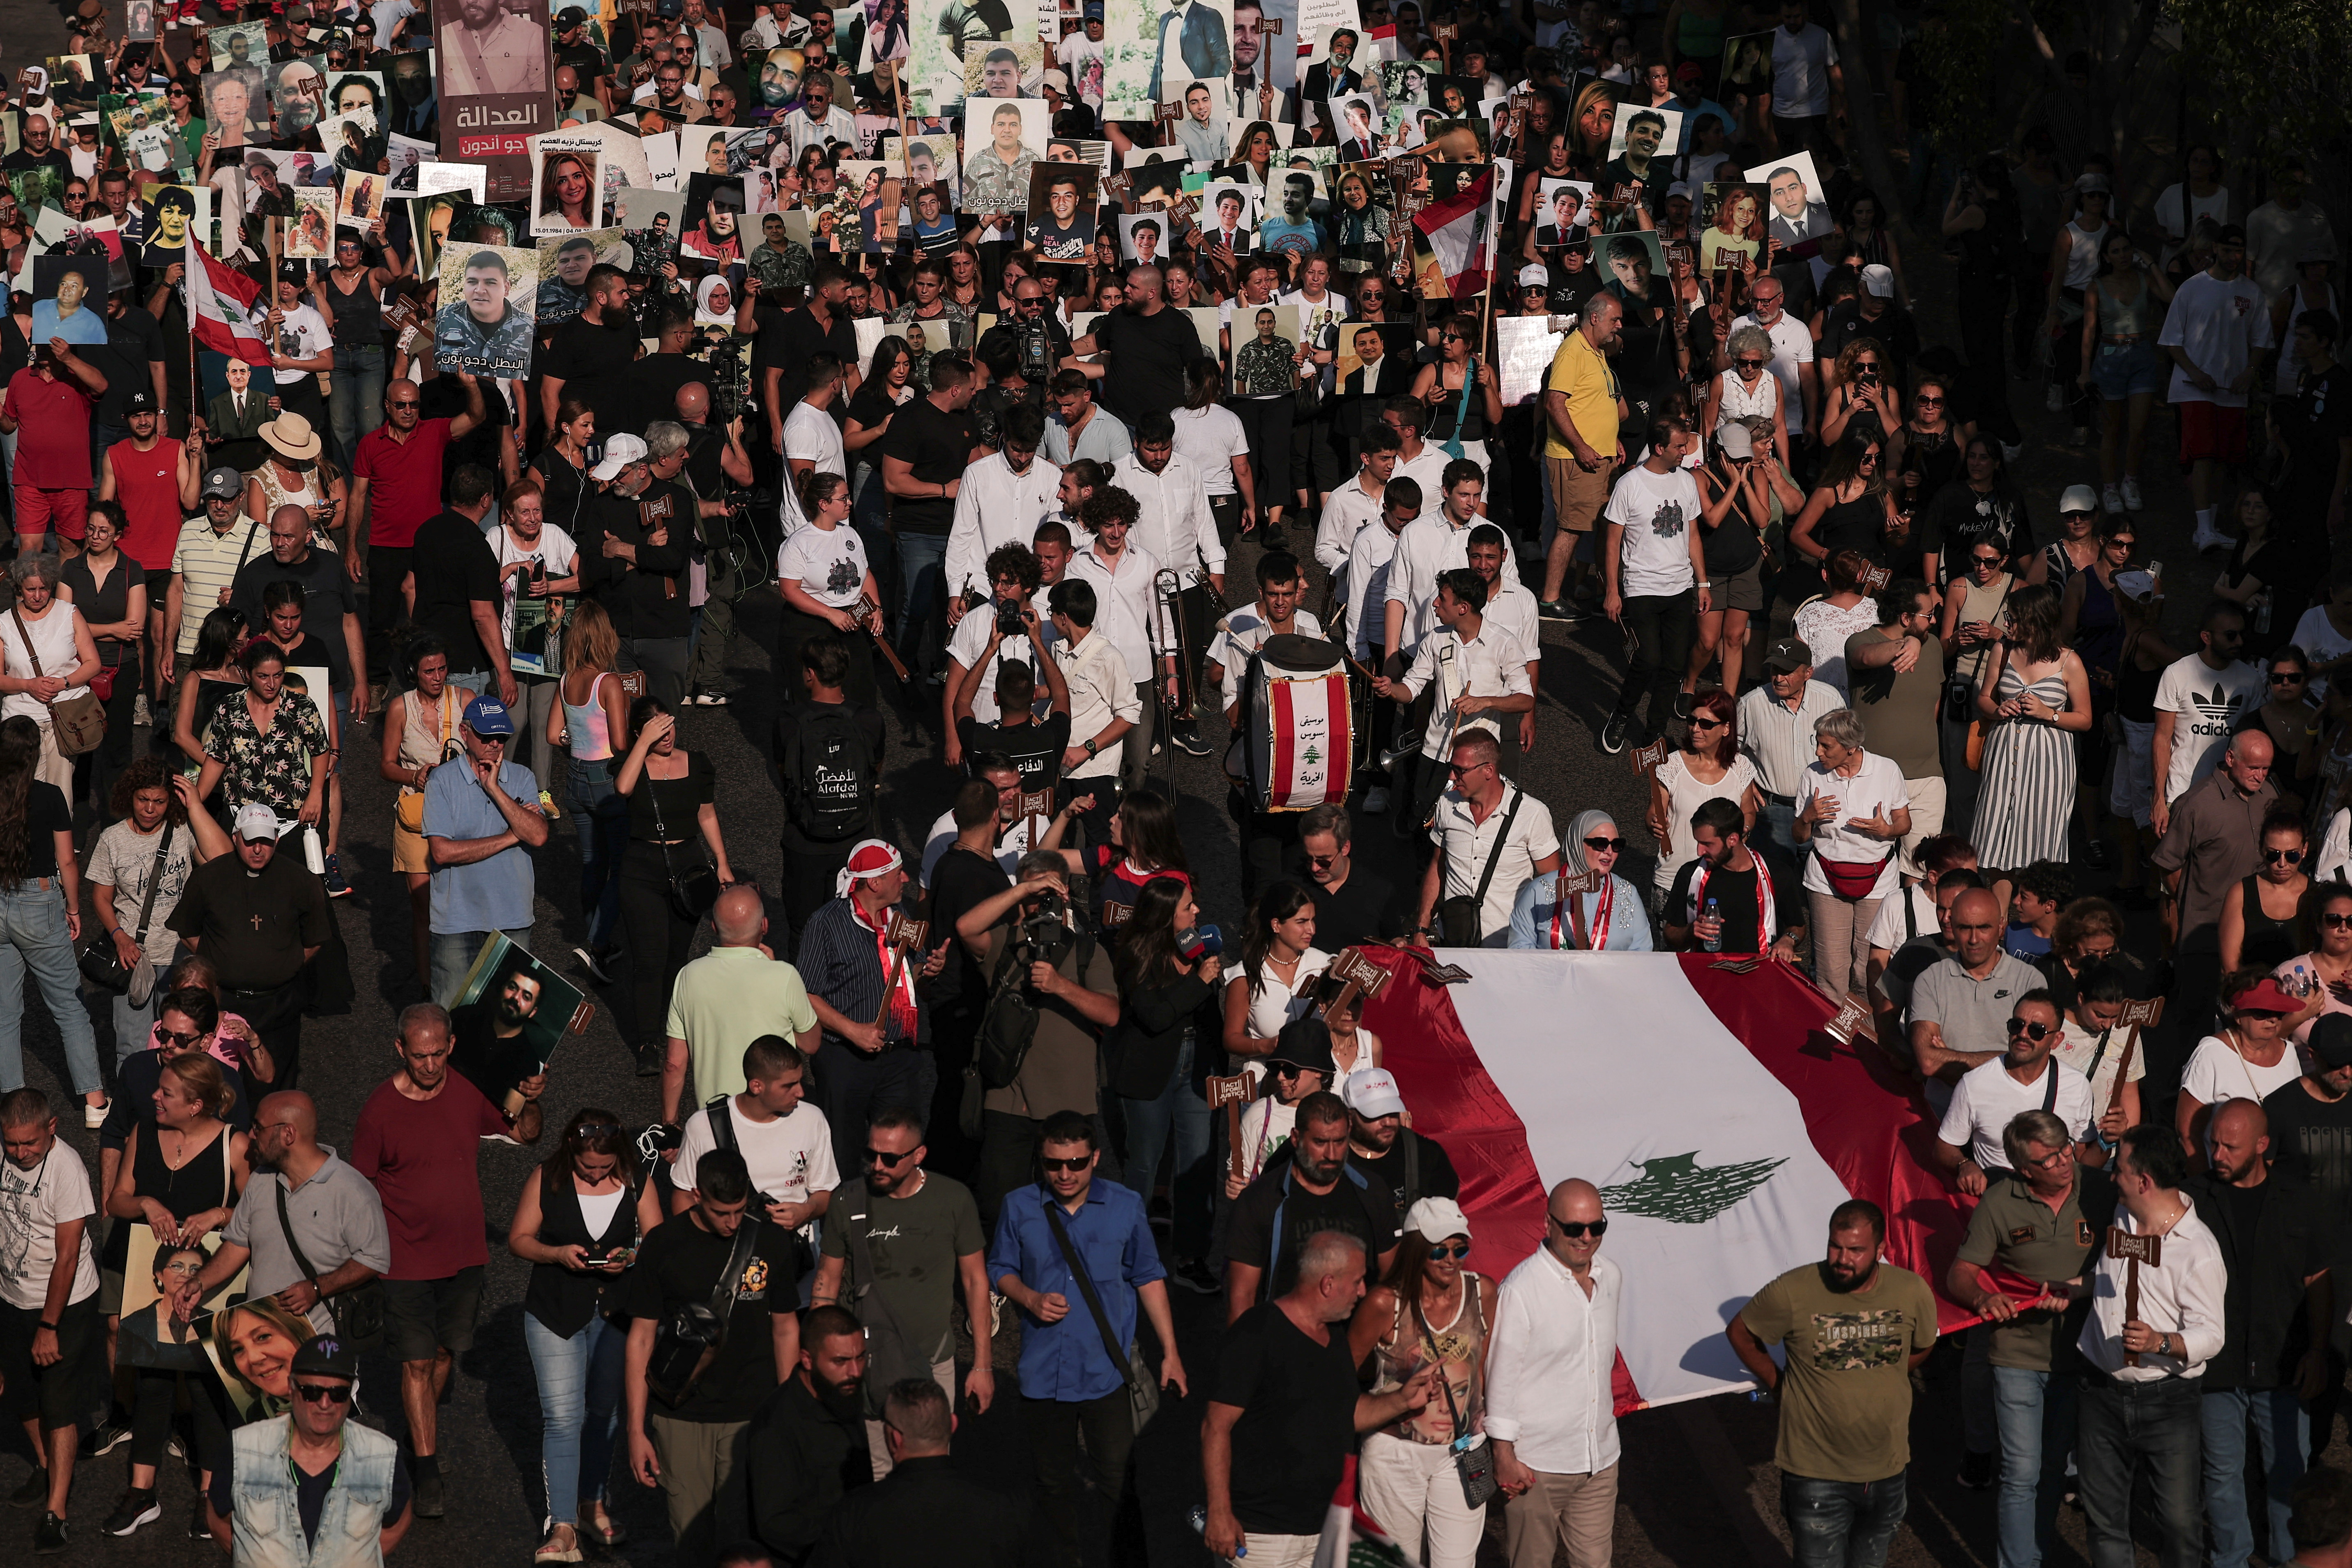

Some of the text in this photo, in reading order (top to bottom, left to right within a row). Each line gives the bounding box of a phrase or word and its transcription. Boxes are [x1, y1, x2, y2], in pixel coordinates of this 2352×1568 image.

[1307, 0, 1339, 11] المطلوبين
[1304, 13, 1333, 21] وظائفهم
[457, 104, 538, 127] العدالة
[142, 145, 159, 154] adidas
[462, 135, 524, 155] جو أندون
[655, 168, 676, 182] لمحو
[968, 197, 1007, 207] دجو نون
[1178, 208, 1191, 217] JUSTICE
[2235, 300, 2249, 309] BULLS
[540, 308, 580, 320] دجو نون
[441, 354, 524, 370] البطل دجو نون
[650, 508, 667, 516] JUSTICE
[1866, 576, 1883, 585] JUSTICE
[856, 606, 869, 621] JUSTICE
[857, 607, 867, 615] FOR
[1300, 716, 1324, 727] موسيقى
[1300, 730, 1325, 740] بسوس
[2191, 722, 2233, 737] adida
[828, 744, 840, 753] LIU
[1642, 755, 1660, 765] JUSTICE
[816, 769, 856, 784] الأفضل
[1300, 771, 1323, 783] الخيرية
[817, 783, 858, 794] Alafdal
[137, 858, 186, 896] feless
[1567, 883, 1590, 892] JUSTICE
[898, 931, 917, 940] JUSTICE
[1180, 933, 1194, 945] العربية
[1360, 968, 1372, 979] FOR
[1362, 964, 1374, 974] ACT
[1351, 969, 1374, 985] JUSTICE
[1839, 1009, 1848, 1020] ACT
[1842, 1011, 1853, 1023] FOR
[1844, 1009, 1860, 1031] JUSTICE
[1220, 1090, 1245, 1099] JUSTICE
[2119, 1246, 2146, 1256] JUSTICE
[318, 1340, 339, 1359] NYC
